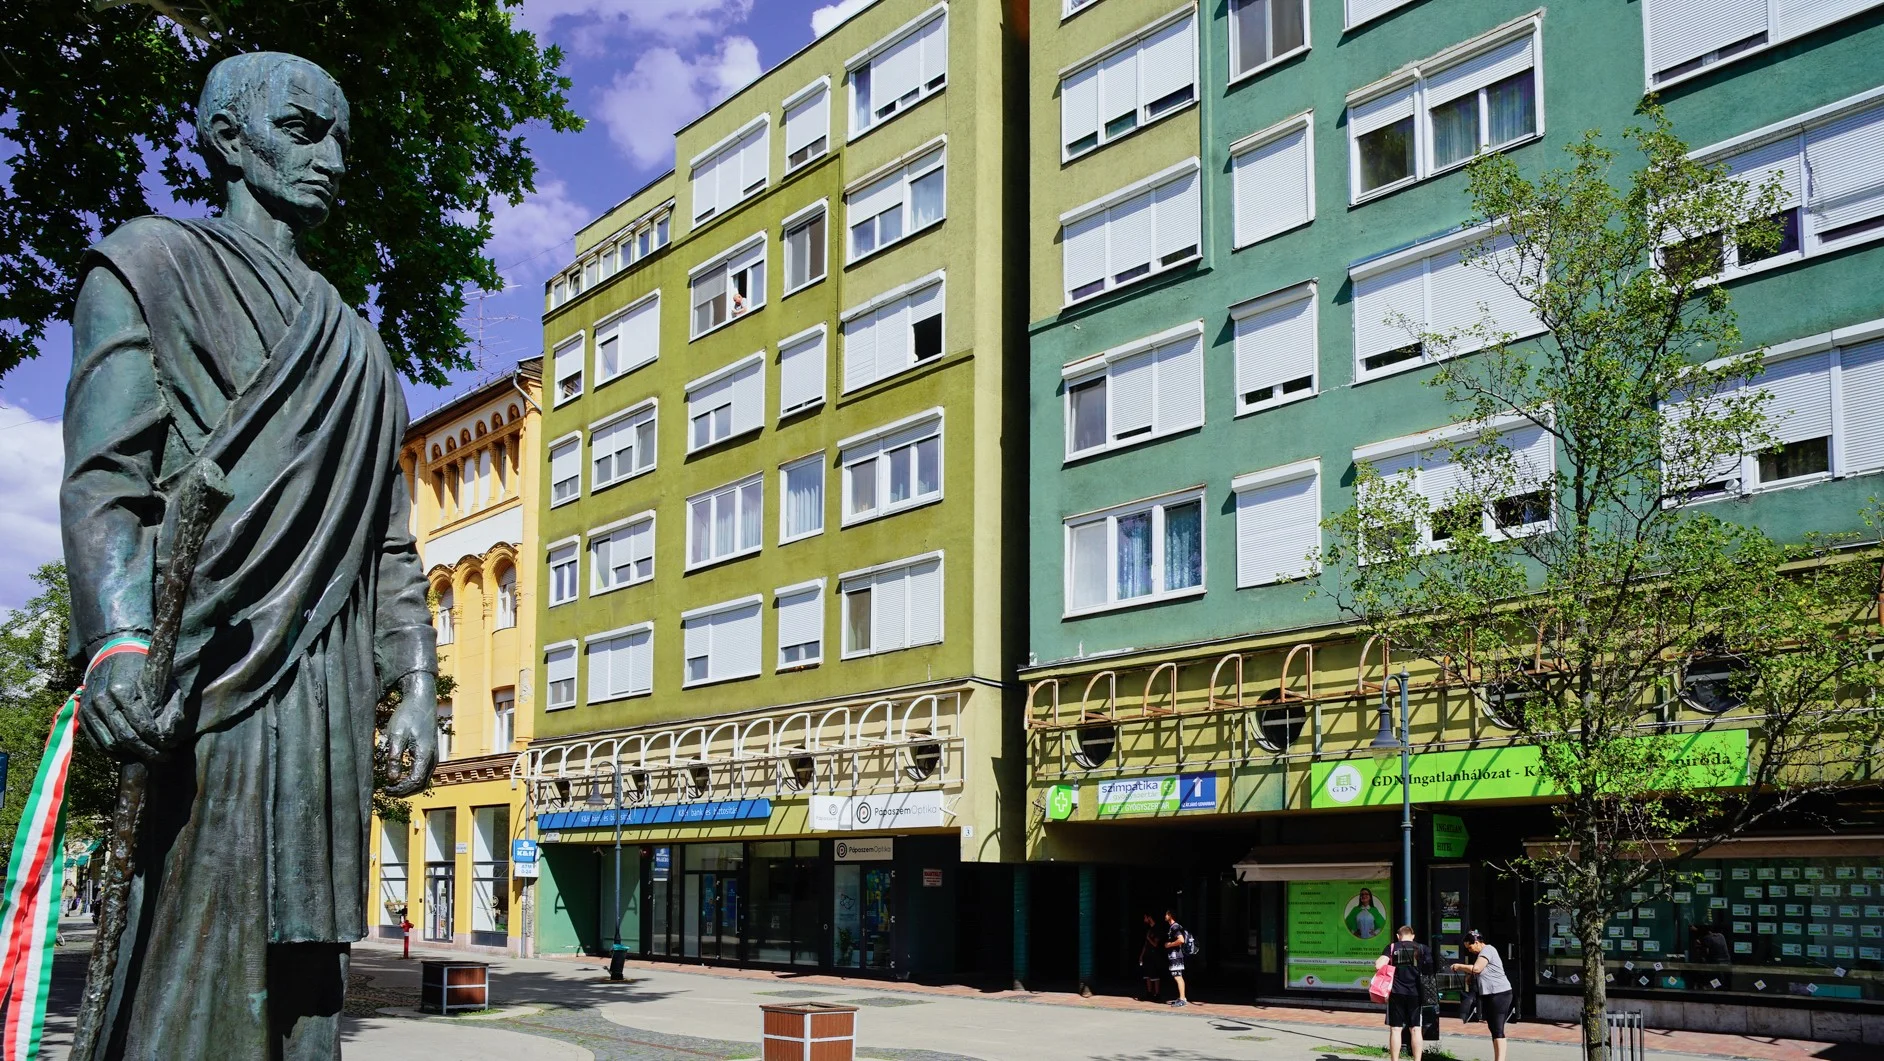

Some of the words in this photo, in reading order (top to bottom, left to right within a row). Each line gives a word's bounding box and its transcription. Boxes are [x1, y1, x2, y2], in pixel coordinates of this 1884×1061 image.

[1372, 775, 1405, 787] GDN
[1409, 768, 1511, 788] Ingatlanhálózat
[1101, 780, 1158, 794] szimpatika
[1332, 785, 1357, 793] GDN
